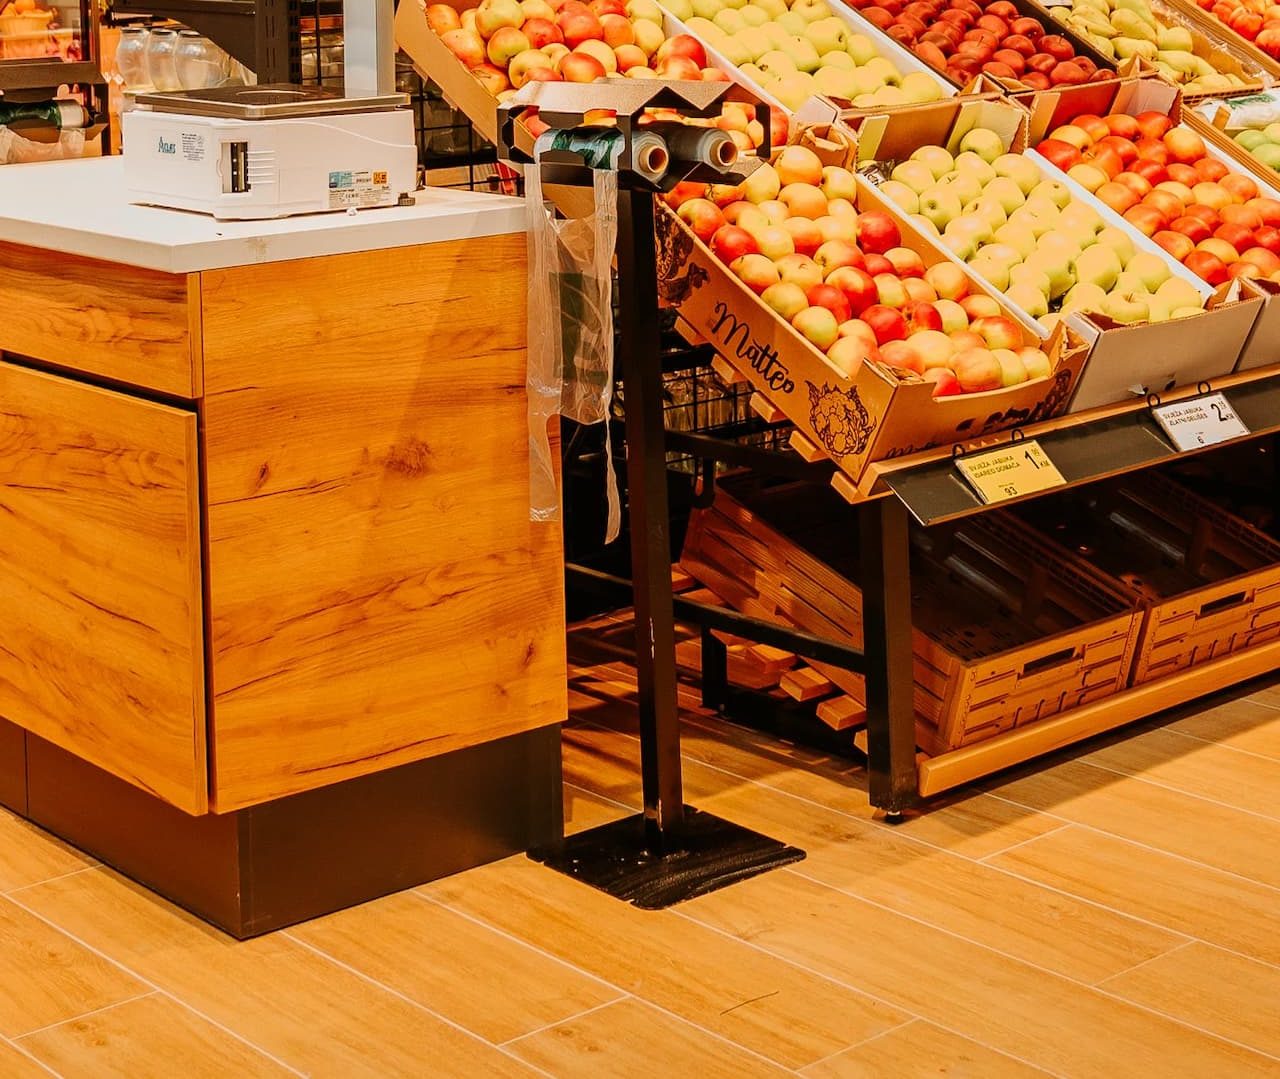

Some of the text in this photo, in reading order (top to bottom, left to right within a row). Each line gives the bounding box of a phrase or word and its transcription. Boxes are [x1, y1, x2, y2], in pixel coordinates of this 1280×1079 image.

[710, 301, 796, 395] Matteo
[1210, 403, 1227, 422] 2
[1024, 449, 1040, 470] 1
[1004, 486, 1018, 496] 93
